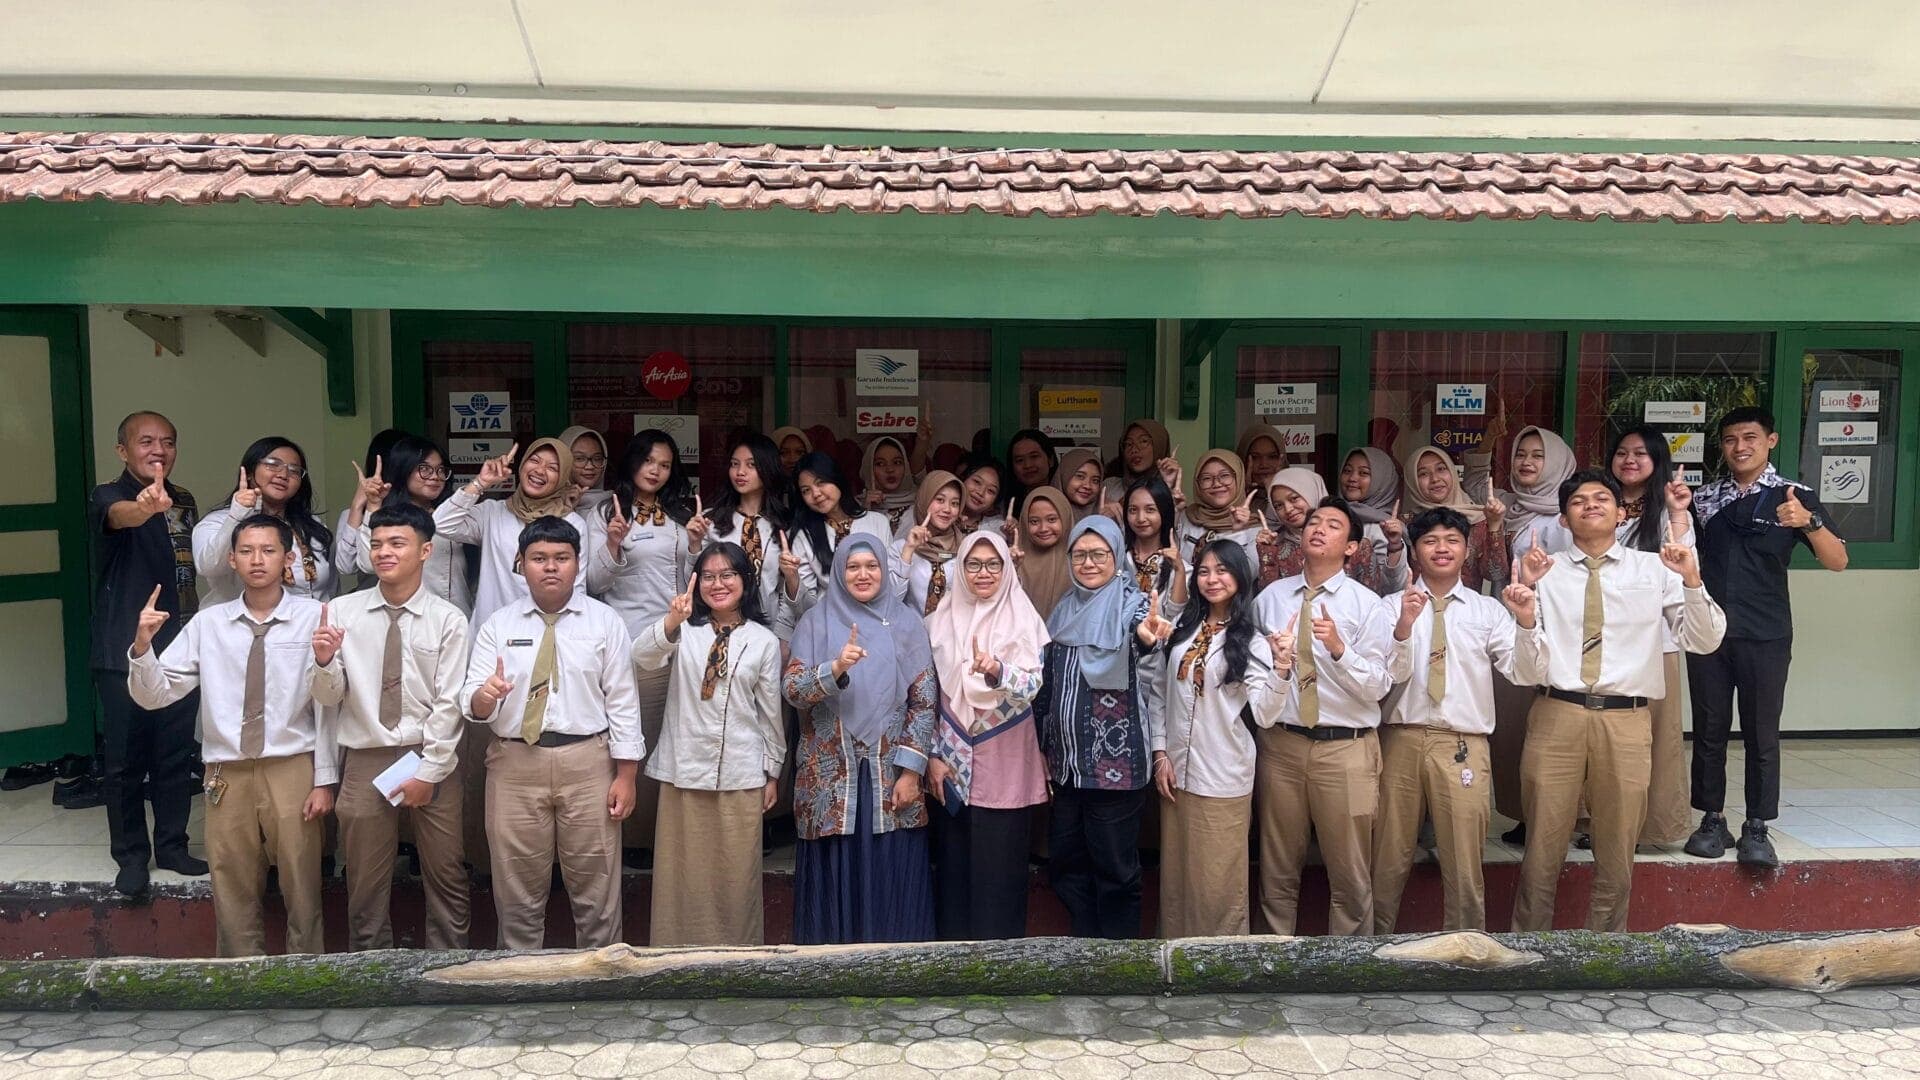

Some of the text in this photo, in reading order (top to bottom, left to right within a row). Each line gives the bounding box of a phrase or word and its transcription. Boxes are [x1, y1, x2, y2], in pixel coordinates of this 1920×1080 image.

[1056, 395, 1098, 404] Lufthansa
[1256, 397, 1315, 406] CATHAY PACIFIC
[1441, 398, 1483, 409] KLM
[1821, 396, 1879, 407] Lion Air
[460, 417, 502, 430] IATA
[857, 411, 917, 428] Sabre
[1292, 432, 1311, 447] air
[1452, 432, 1483, 444] THA
